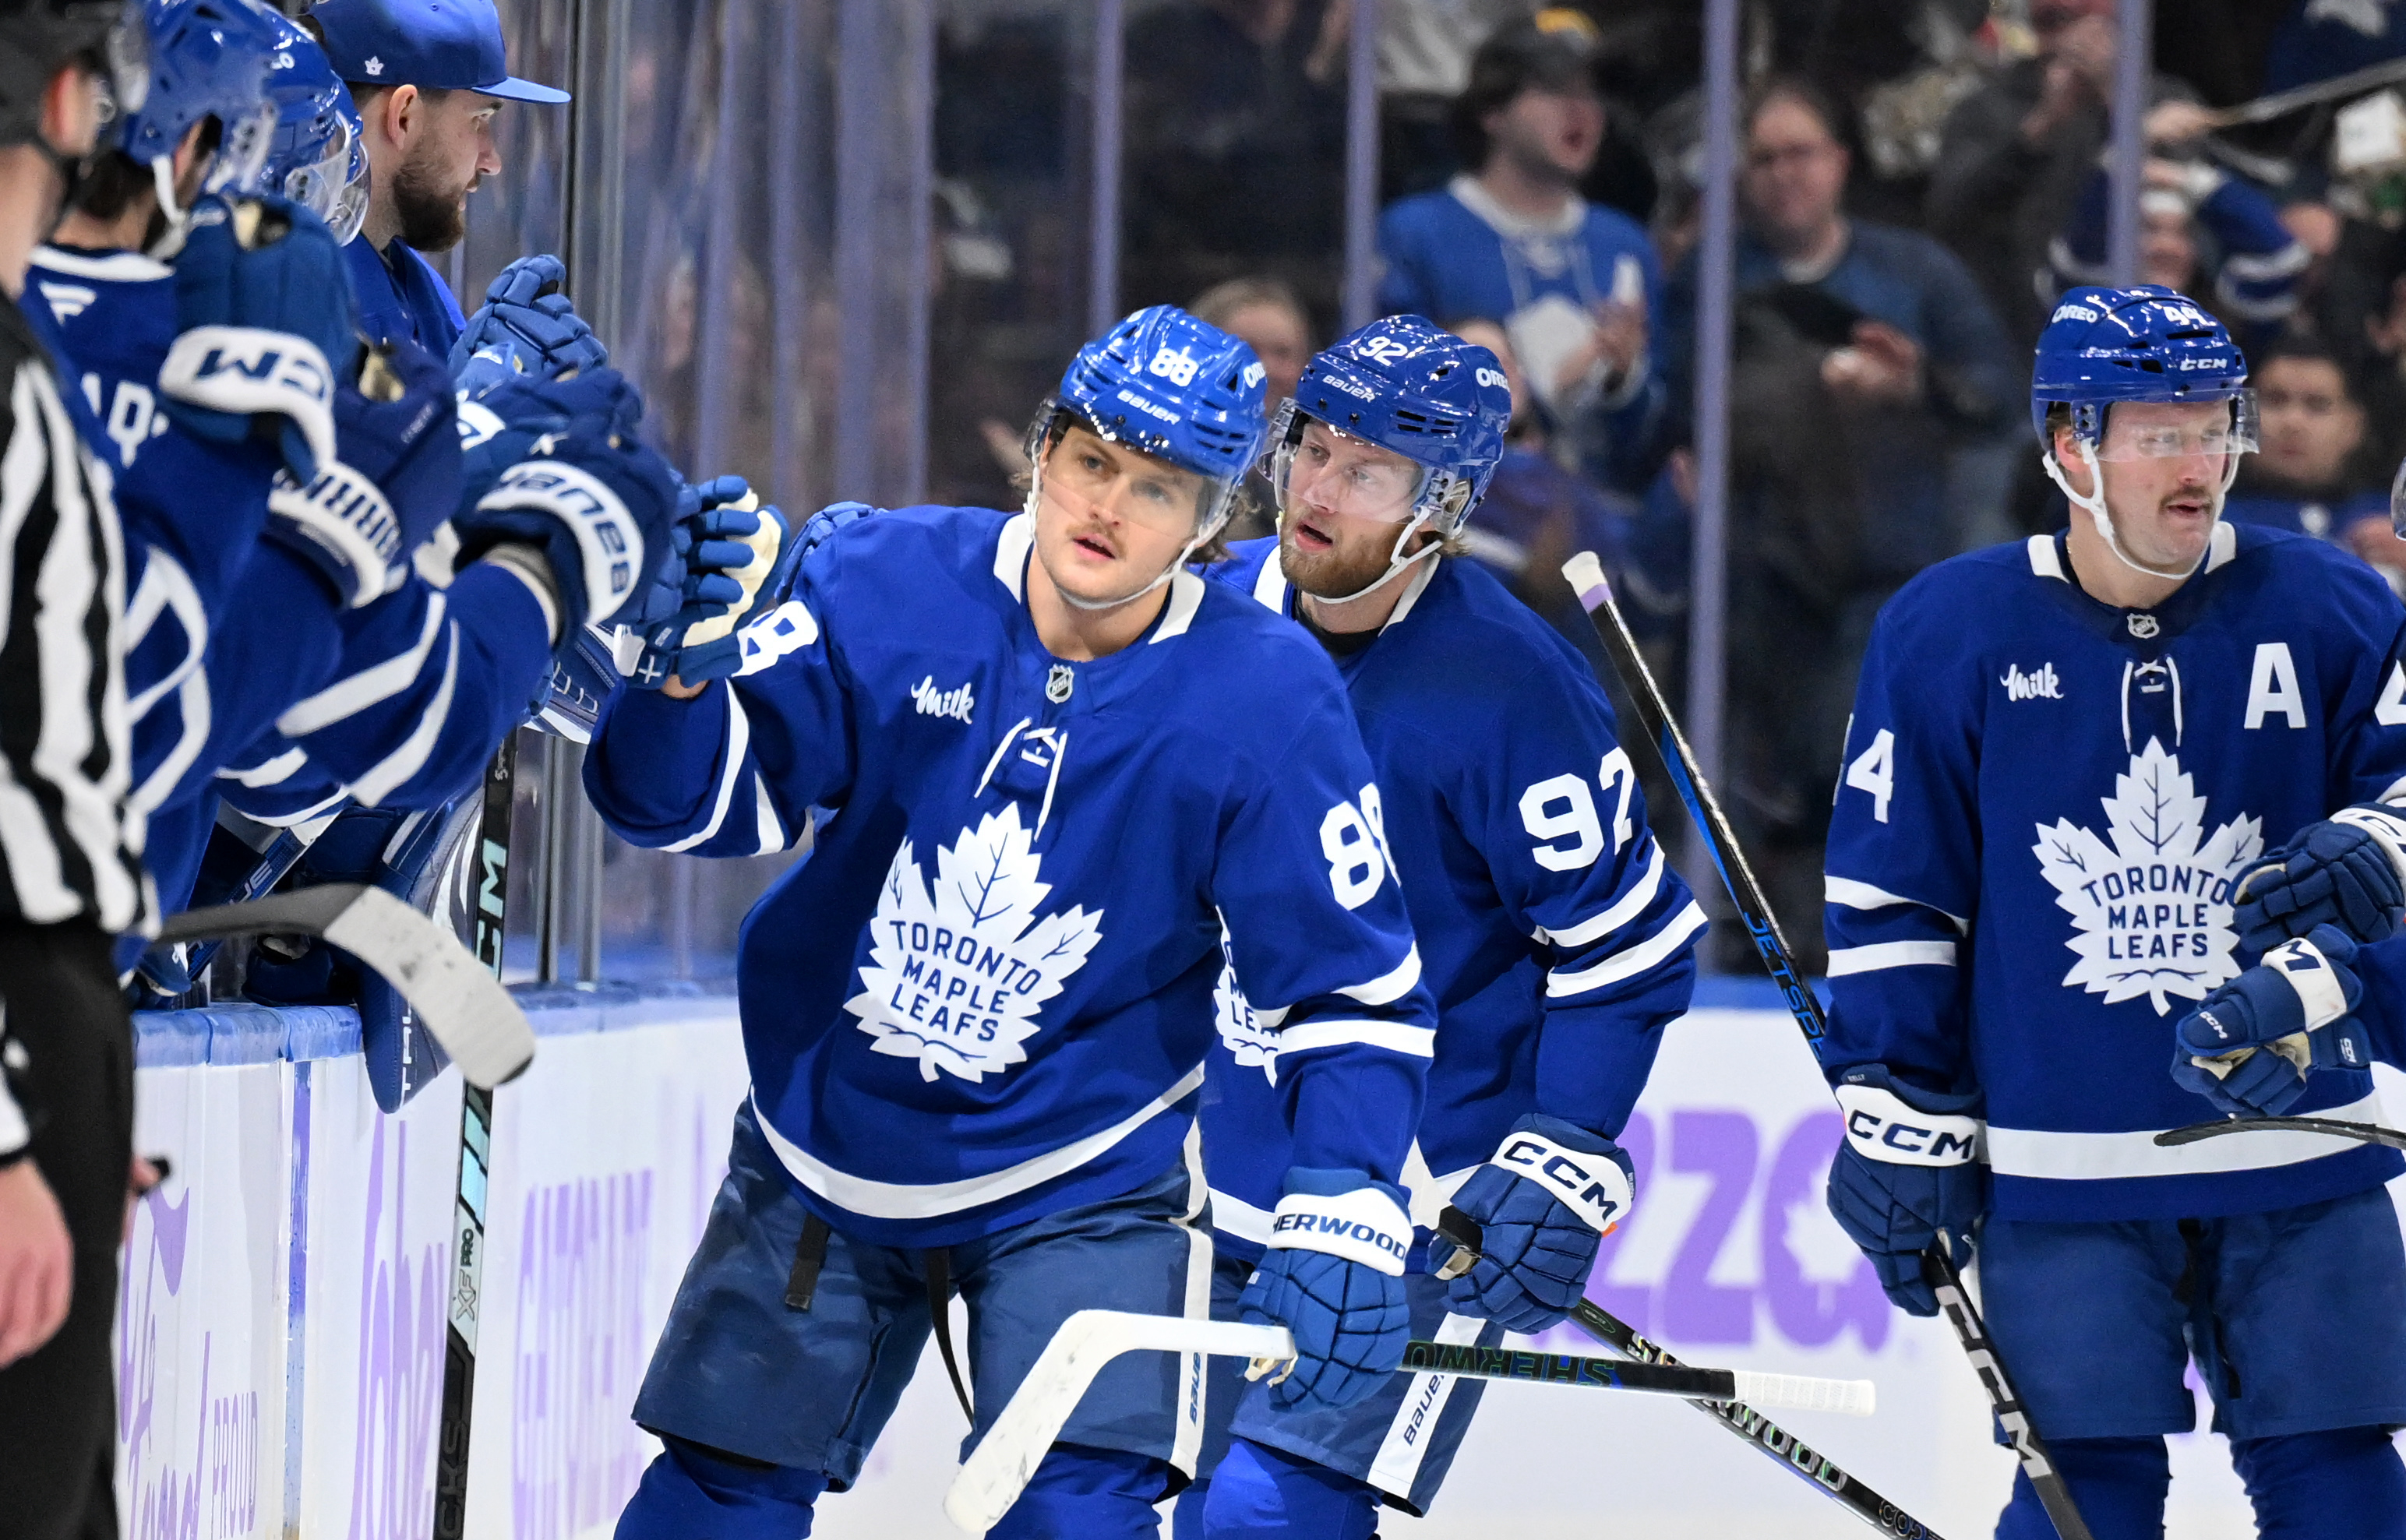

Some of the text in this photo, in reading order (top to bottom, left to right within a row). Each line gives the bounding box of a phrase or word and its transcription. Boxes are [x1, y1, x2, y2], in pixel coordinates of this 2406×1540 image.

[2051, 305, 2097, 324] OREO
[1149, 347, 1199, 386] 88
[1358, 336, 1408, 366] 92
[2179, 358, 2228, 372] CCM
[1476, 368, 1511, 392] ORE
[911, 675, 975, 725] Milk
[1999, 662, 2065, 702] Milk
[2244, 643, 2307, 728] A
[1518, 746, 1635, 872] 92
[2080, 864, 2231, 907] TORONTO
[477, 838, 508, 984] CM
[2108, 904, 2208, 929] MAPLE
[889, 920, 1041, 996] TORONTO
[2108, 932, 2207, 959] LEAFS
[901, 954, 1010, 1013] MAPLE
[1744, 911, 1824, 1062] JETSPE
[889, 983, 999, 1042] LEAFS
[2199, 1011, 2228, 1040] CCM
[1848, 1108, 1974, 1168] CCM
[1503, 1140, 1618, 1223] CCM
[460, 1228, 474, 1267] PRO
[1272, 1213, 1406, 1260] ERWOOD
[1402, 1340, 1615, 1387] SHERWO
[1935, 1285, 2053, 1478] CCM
[210, 1390, 258, 1540] PROUD
[438, 1418, 468, 1539] CKS
